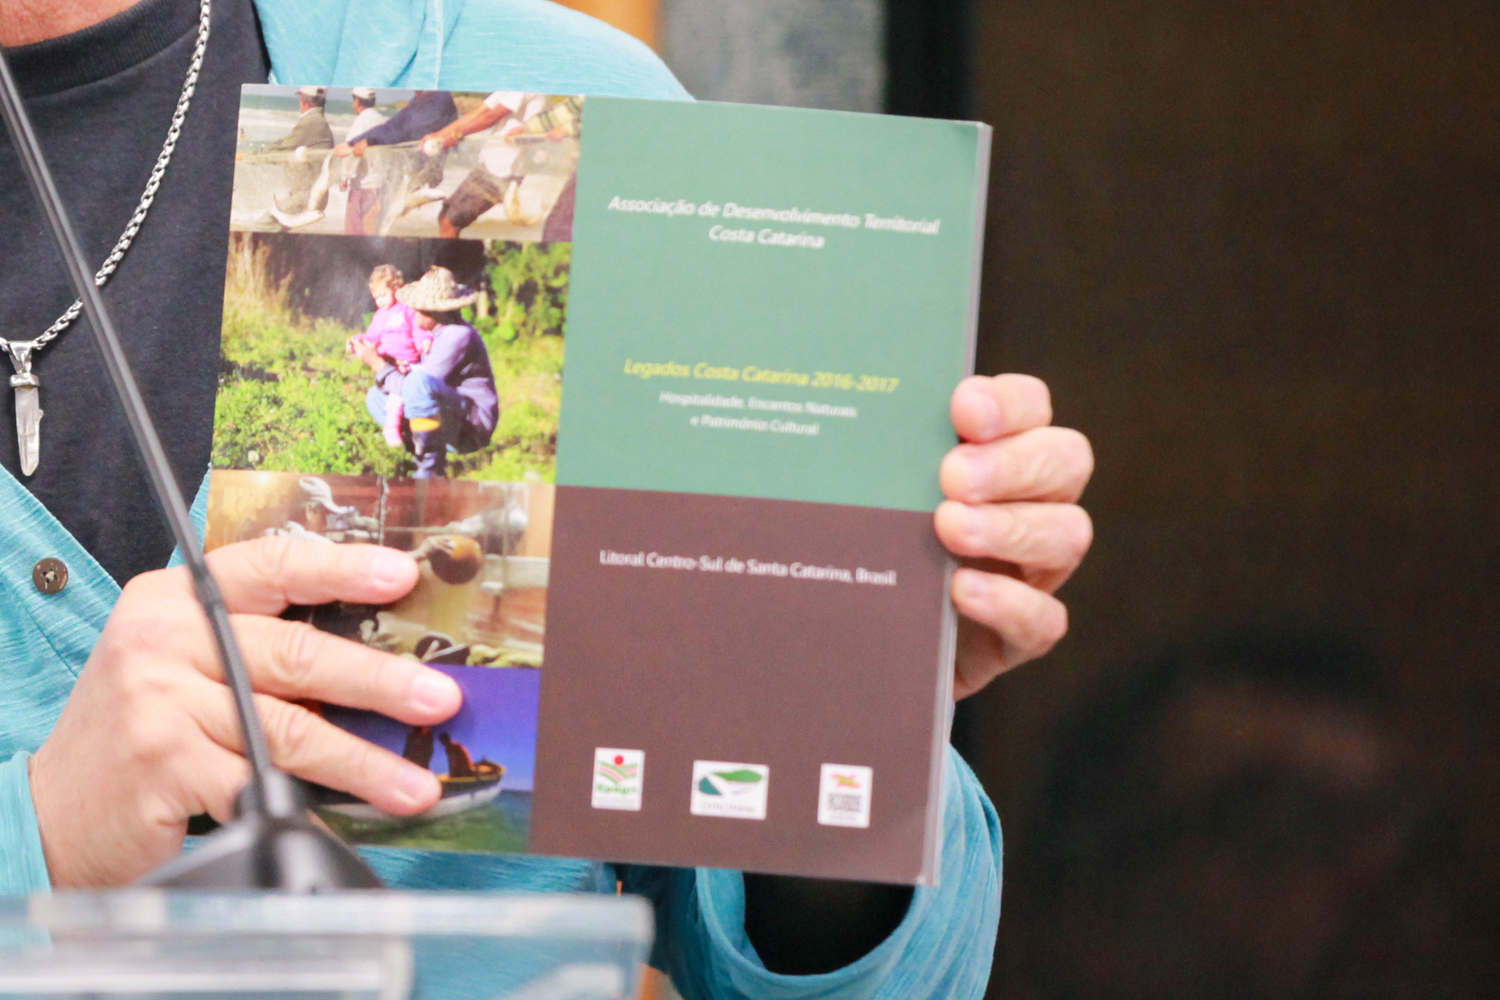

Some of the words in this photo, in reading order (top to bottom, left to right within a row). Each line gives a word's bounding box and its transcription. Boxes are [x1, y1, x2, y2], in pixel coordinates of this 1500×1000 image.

[607, 196, 696, 216] Associação
[698, 201, 720, 217] de
[722, 202, 861, 228] Desenvolvimento
[864, 213, 941, 235] Territorial
[709, 225, 755, 243] Costa
[757, 229, 825, 249] Catarina
[623, 358, 691, 379] Legados
[693, 363, 740, 381] Costa
[742, 366, 810, 386] Catarina
[811, 371, 900, 393] 2016-2017
[748, 396, 804, 413] Encantos
[805, 401, 858, 418] Naturais
[769, 419, 820, 436] Cultural
[599, 550, 645, 566] Litoral
[646, 552, 723, 572] Centro-Sul
[724, 557, 746, 574] de
[746, 559, 789, 577] Santa
[789, 562, 854, 583] Catarina,
[855, 567, 898, 586] Brasil
